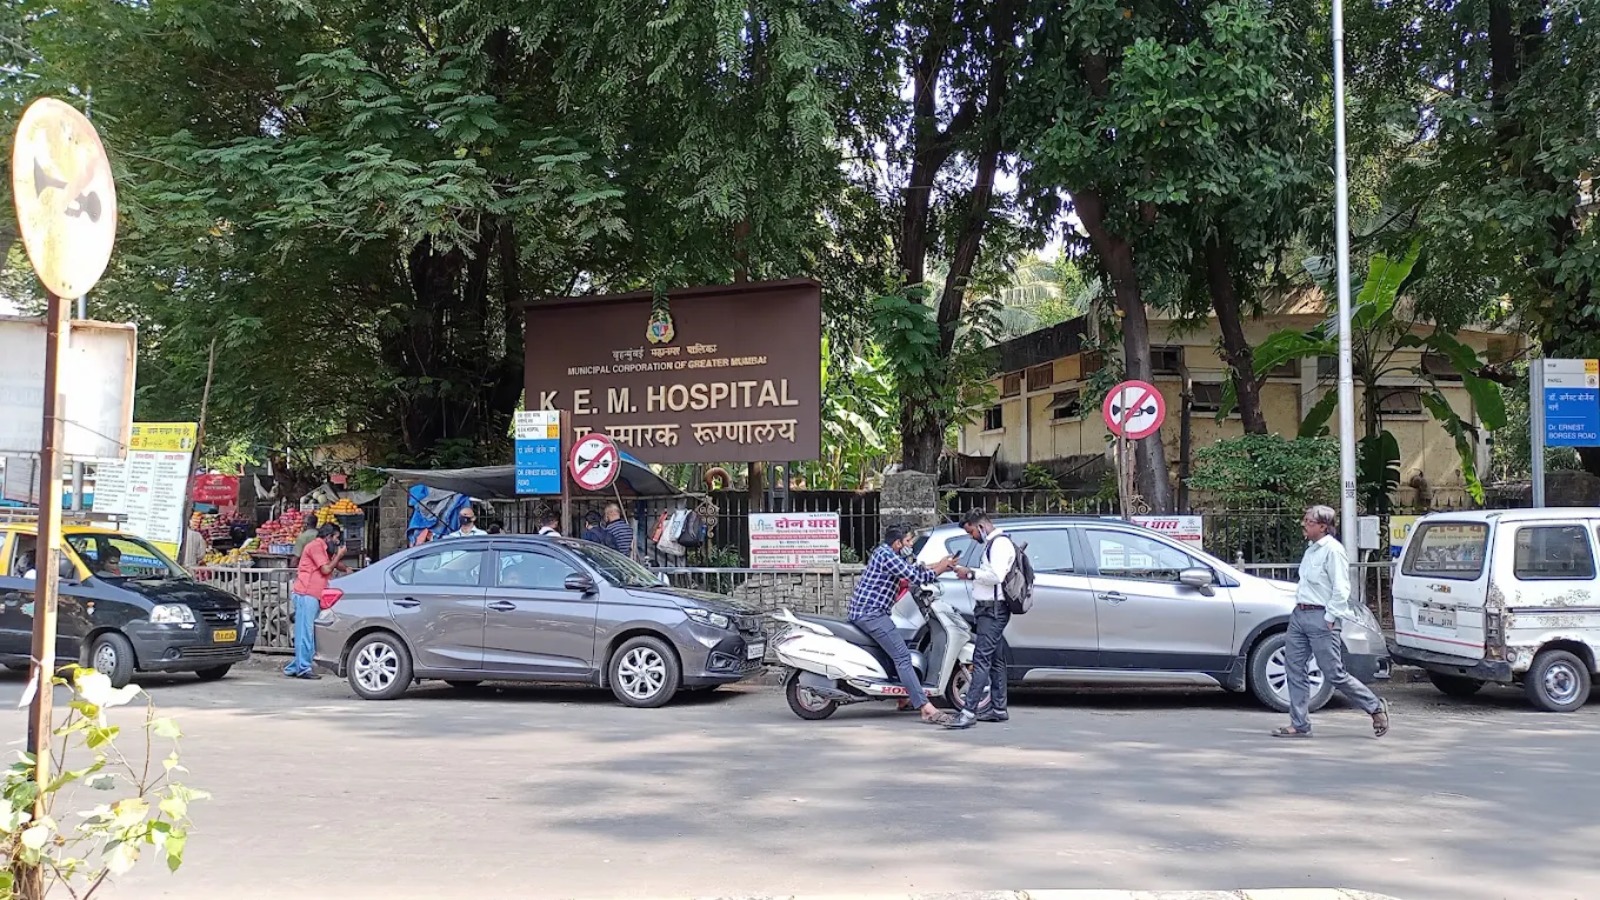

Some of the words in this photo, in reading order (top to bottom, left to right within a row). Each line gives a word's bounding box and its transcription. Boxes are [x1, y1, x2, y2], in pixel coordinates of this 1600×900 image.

[567, 365, 611, 376] MUNICIPAL
[612, 362, 673, 374] CORPORATION
[674, 361, 687, 370] OF
[688, 357, 729, 369] GREATER
[730, 356, 767, 367] MUMBAI
[573, 389, 599, 415] E.
[607, 387, 637, 414] M.
[647, 378, 799, 412] HOSPITAL
[1548, 432, 1577, 440] BORGES
[1577, 432, 1597, 440] ROAD
[880, 686, 932, 697] HONA
